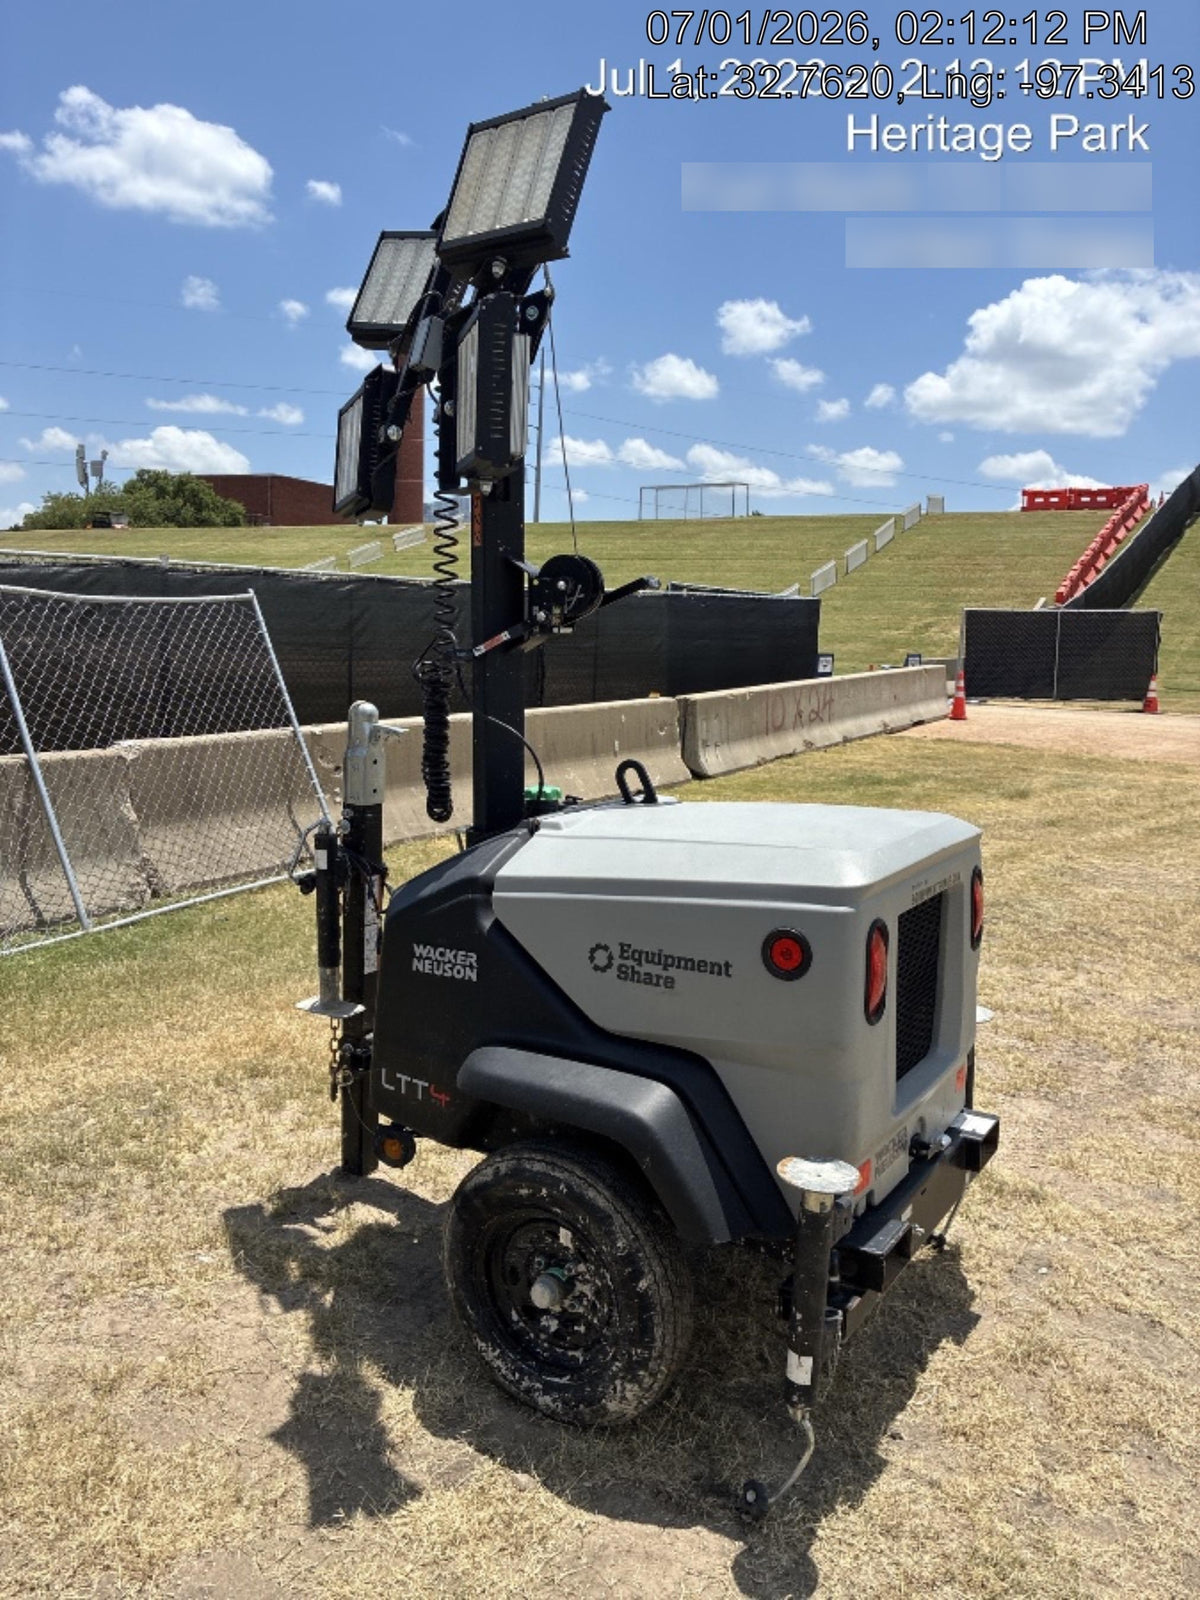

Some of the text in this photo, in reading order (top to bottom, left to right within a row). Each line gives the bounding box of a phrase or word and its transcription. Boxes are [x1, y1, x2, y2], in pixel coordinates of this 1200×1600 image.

[412, 943, 479, 968] WACKER
[618, 942, 733, 978] Equipment
[411, 957, 478, 983] NEUSON
[616, 963, 676, 990] Share
[381, 1067, 451, 1107] LTT4
